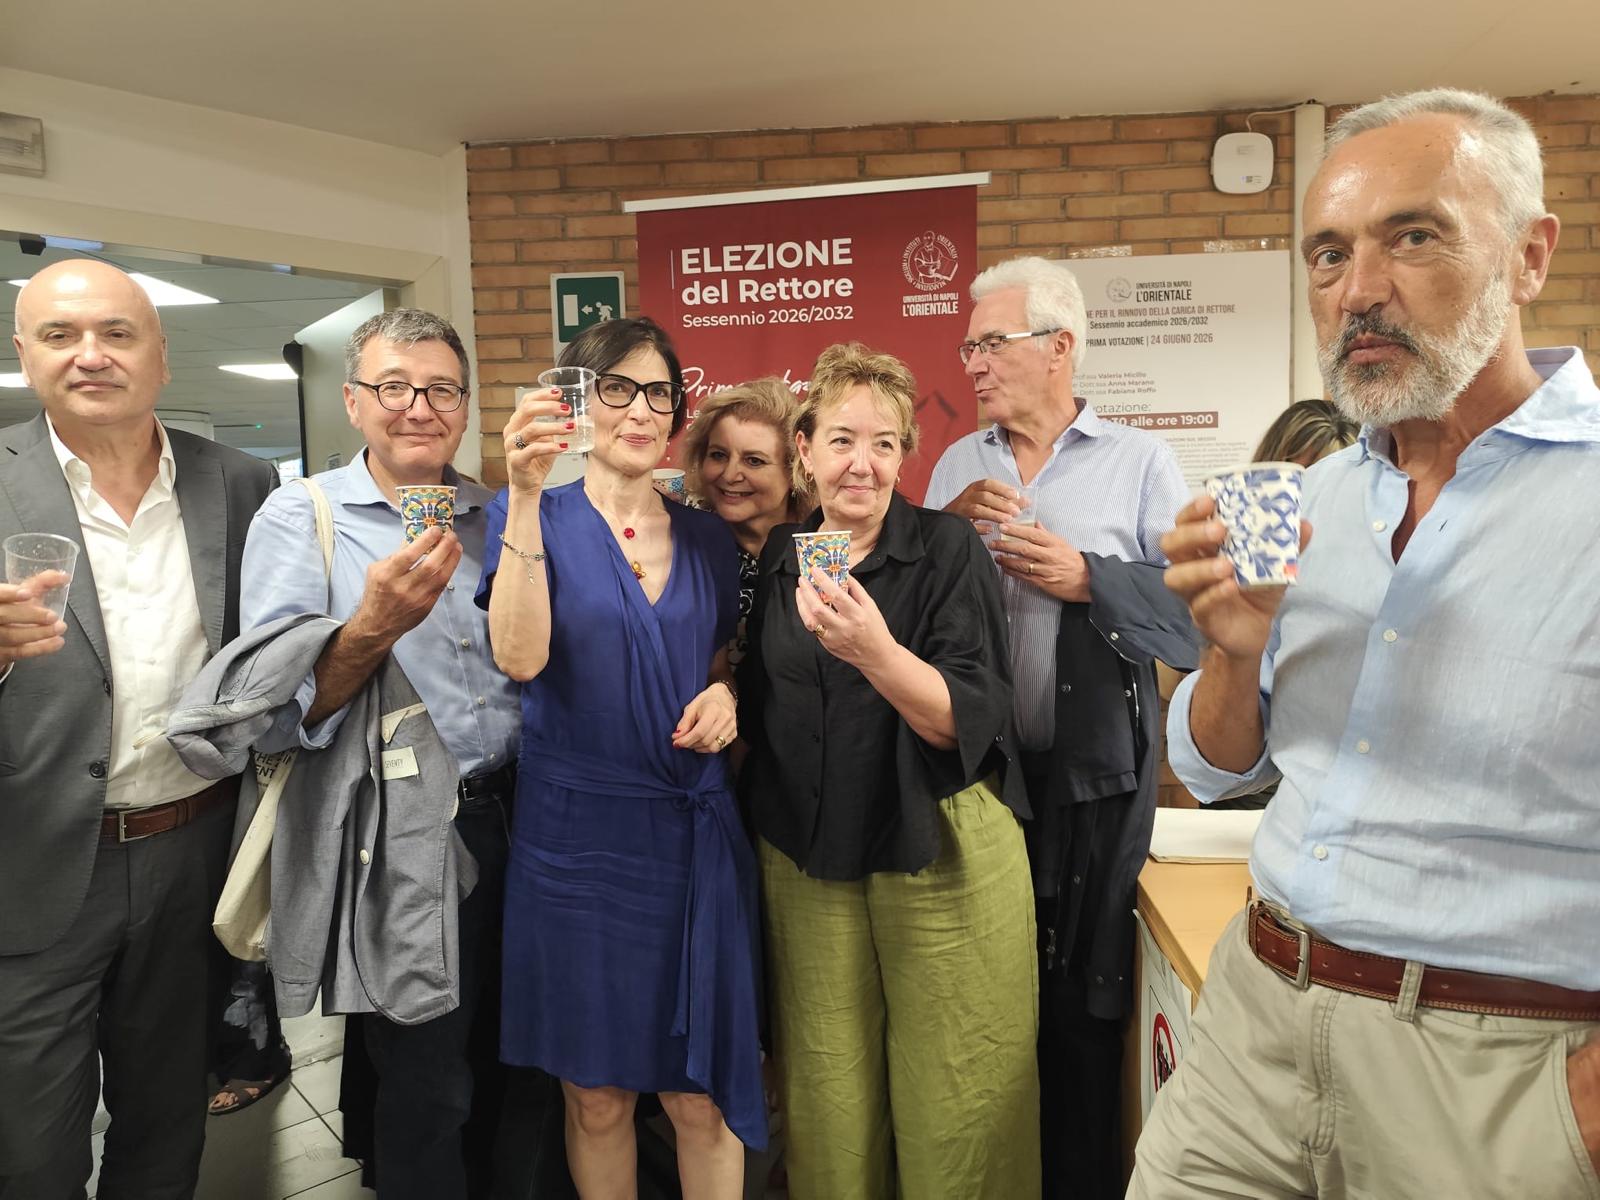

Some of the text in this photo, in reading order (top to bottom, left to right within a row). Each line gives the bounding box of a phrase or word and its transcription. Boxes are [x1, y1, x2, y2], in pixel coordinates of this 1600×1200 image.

[681, 237, 853, 274] ELEZIONE
[681, 276, 854, 306] del Rettore
[902, 292, 959, 303] UNIVERSITÀ DI NAPOLI
[1136, 289, 1192, 302] L'ORIENTALE
[902, 301, 959, 317] L'ORIENTALE
[1095, 310, 1108, 318] PER
[1109, 309, 1116, 318] IL
[1118, 308, 1147, 317] RINNOVO
[1149, 307, 1171, 316] DELLA
[1171, 306, 1196, 315] CARICA
[1197, 305, 1205, 314] DI
[1206, 304, 1236, 314] RETTORE
[682, 305, 854, 328] Sessennio 2026/2032
[1090, 316, 1208, 330] Sessennio accademico 2026/2032
[1086, 337, 1107, 347] PRIMA
[1108, 336, 1145, 346] VOTAZIONE
[1150, 335, 1161, 345] 24
[1163, 334, 1192, 344] GIUGNO
[1193, 333, 1214, 343] 2026
[1130, 416, 1154, 427] alle
[1156, 417, 1178, 426] ore
[1181, 414, 1214, 425] 19:00
